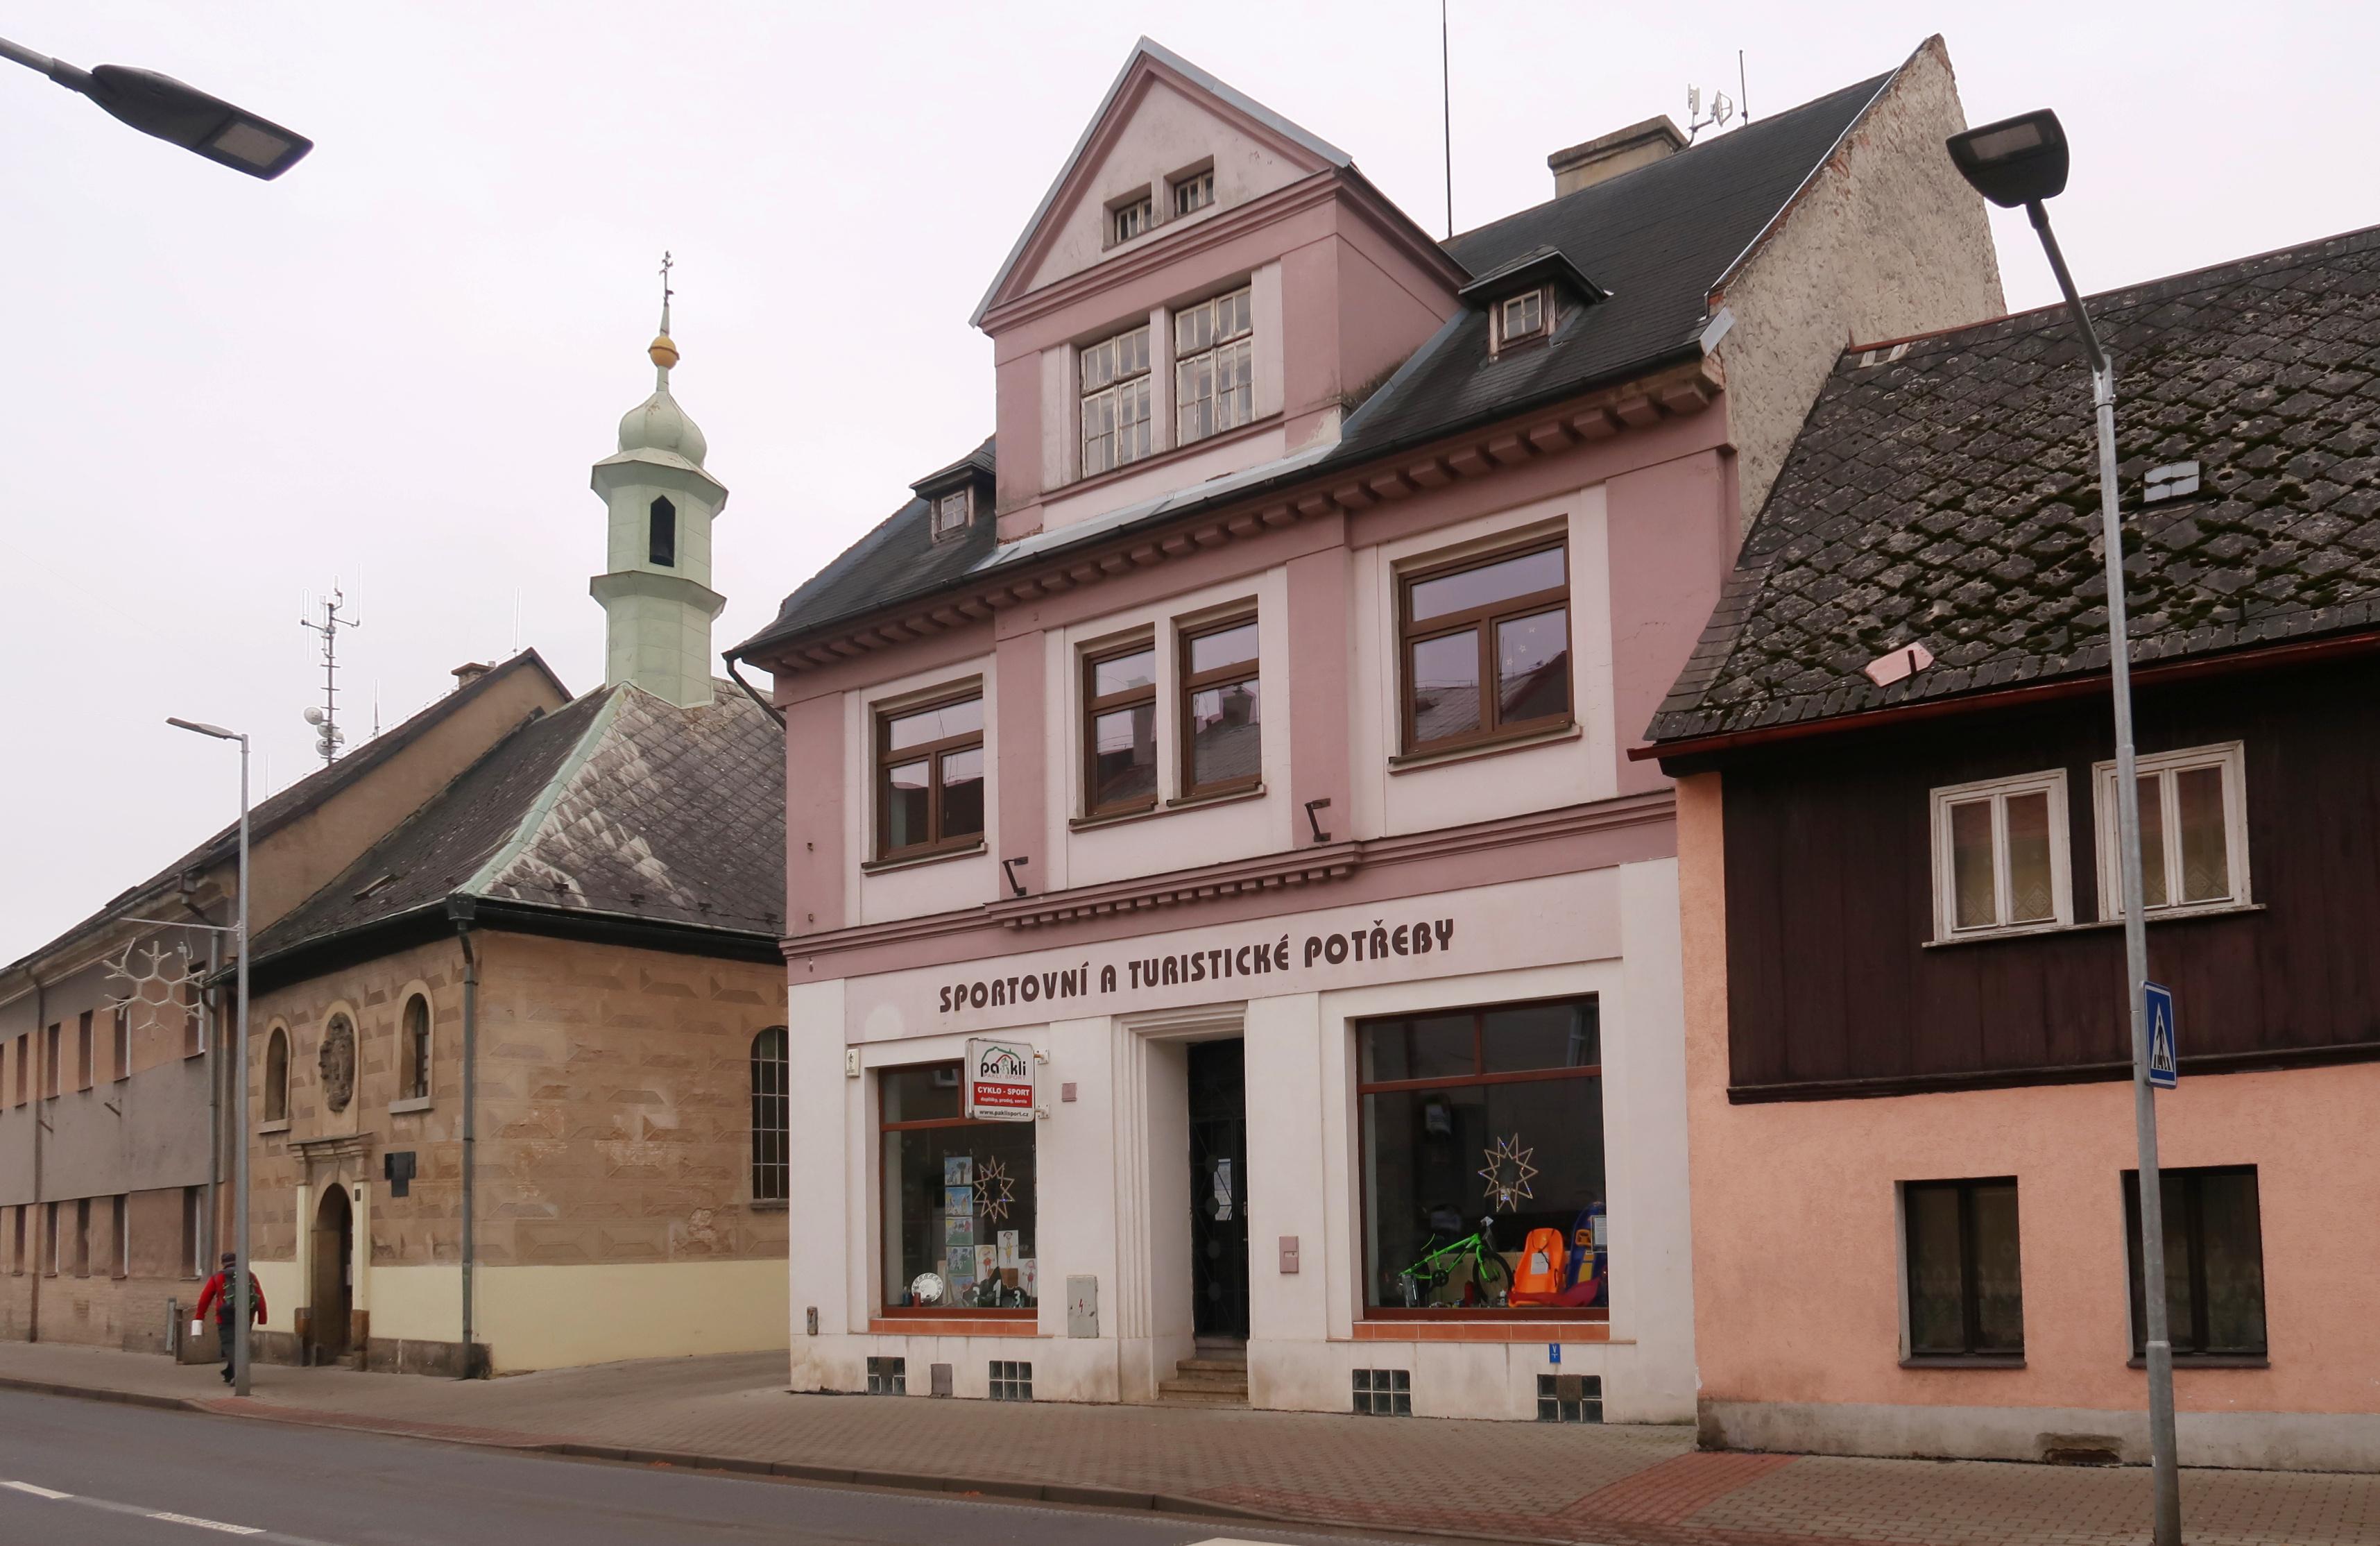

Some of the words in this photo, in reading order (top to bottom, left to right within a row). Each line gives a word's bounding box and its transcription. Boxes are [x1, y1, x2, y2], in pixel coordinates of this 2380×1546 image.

[939, 961, 1089, 1012] SPORTOVNÍ
[1101, 965, 1117, 993] A
[1128, 933, 1290, 989] TURISTICKÉ
[1304, 919, 1454, 968] POTŘEBY
[977, 1086, 1002, 1094] CYKLO
[1007, 1087, 1030, 1096] SPORT
